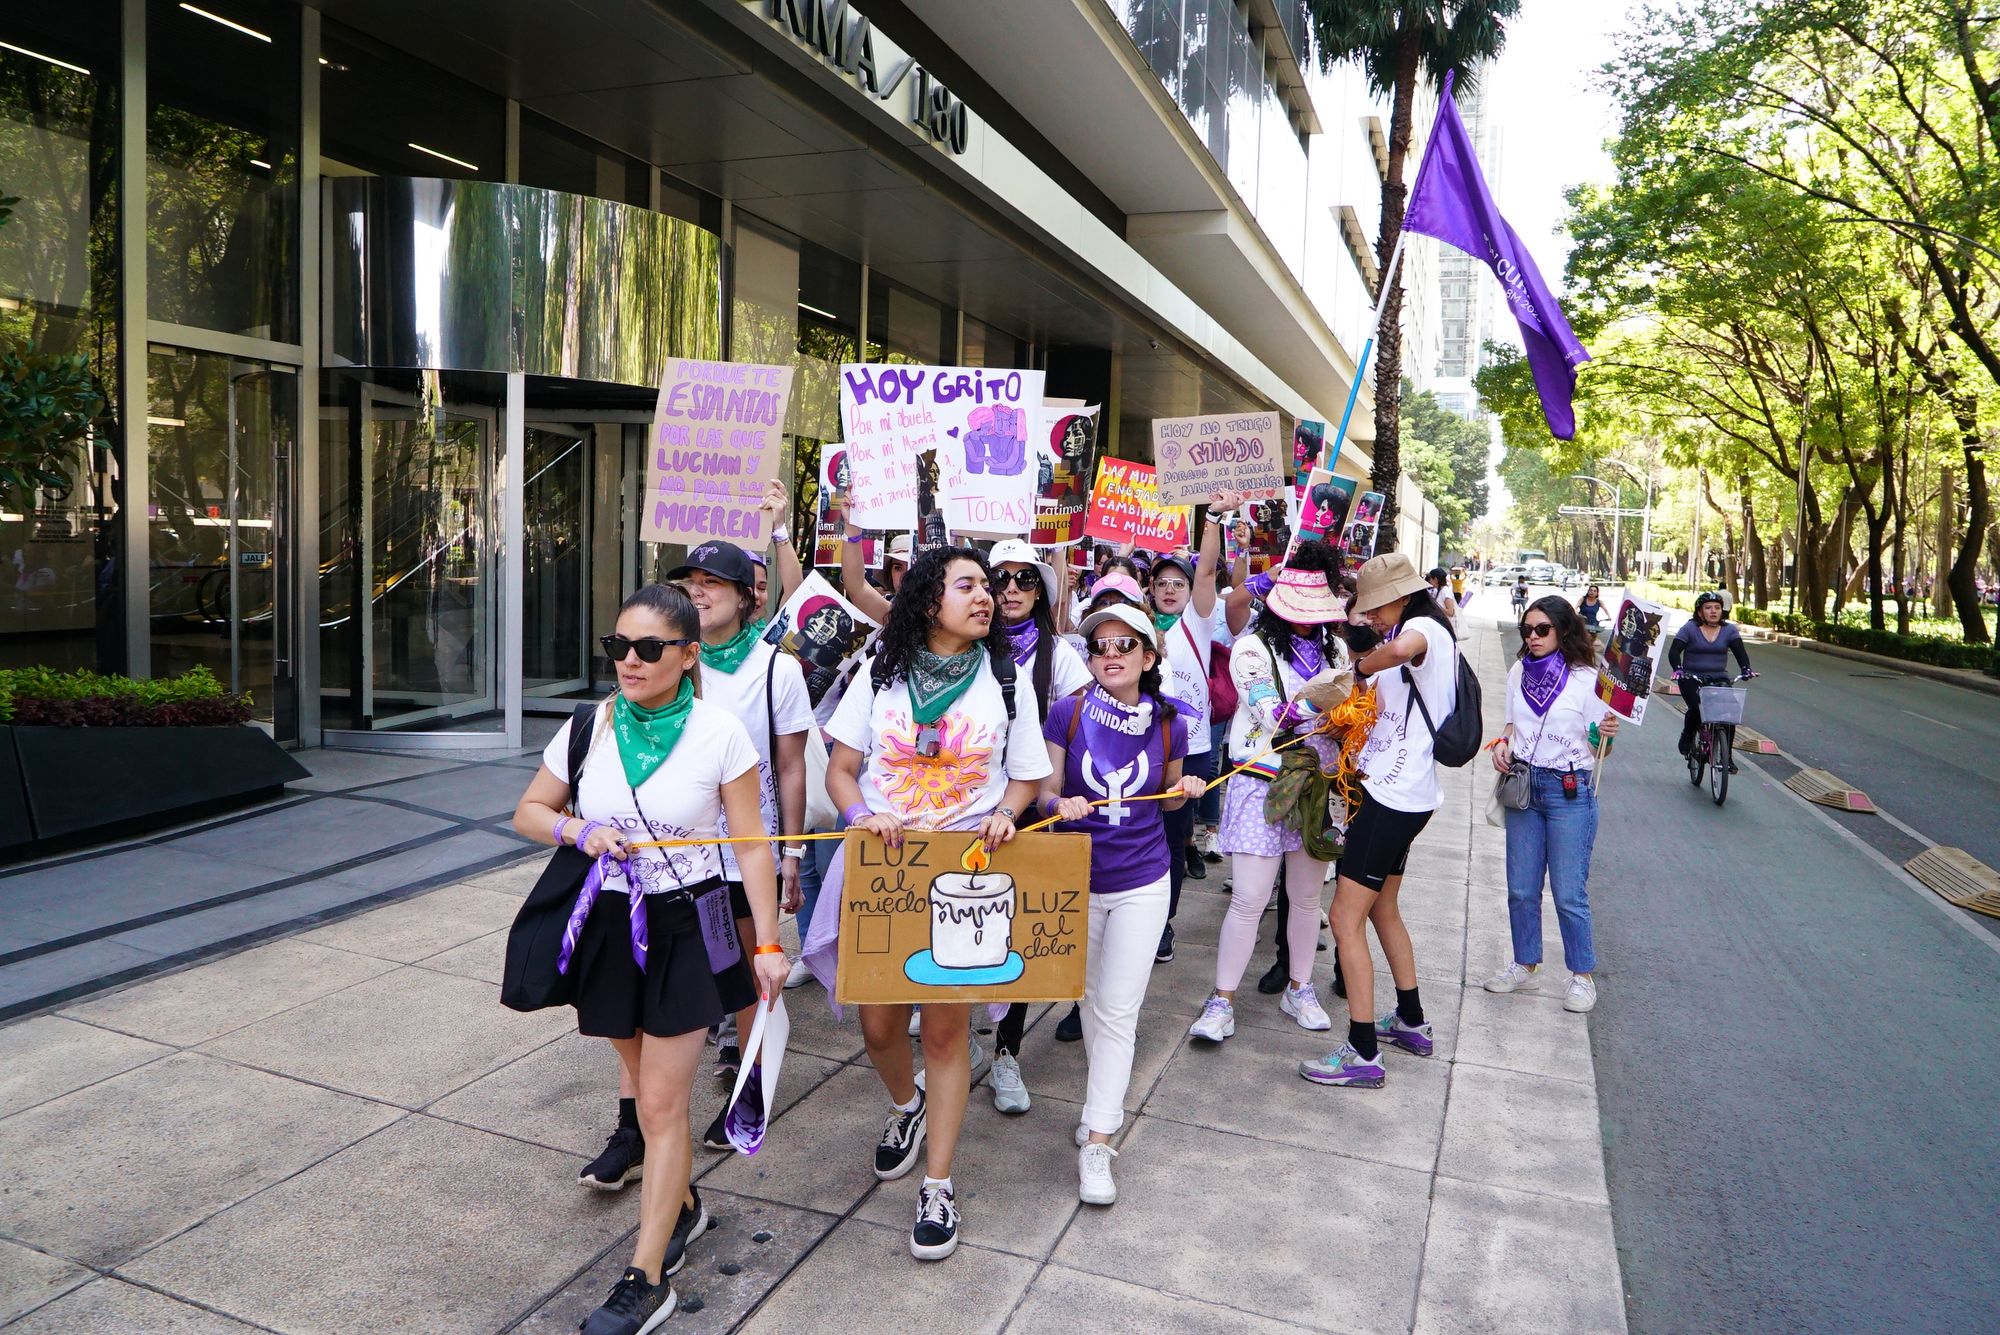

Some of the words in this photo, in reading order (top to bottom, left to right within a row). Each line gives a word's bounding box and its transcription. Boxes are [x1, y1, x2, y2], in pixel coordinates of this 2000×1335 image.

[752, 368, 781, 387] TE
[844, 367, 925, 405] HOY
[665, 382, 781, 427] ESPANTAS
[659, 423, 690, 447] POR
[696, 426, 724, 449] LAS
[730, 429, 766, 450] QUE
[1160, 422, 1194, 439] HOY
[1200, 421, 1220, 436] NO
[1226, 416, 1272, 434] TENGO
[656, 447, 741, 476] LUCHAN
[1102, 463, 1126, 478] LAS
[1129, 470, 1157, 484] MUJ
[658, 475, 686, 497] NO
[693, 478, 733, 504] POR
[1107, 482, 1159, 502] ENOJAD
[654, 501, 761, 540] MUEREN
[1036, 503, 1083, 516] Latimos
[1036, 519, 1072, 530] juntas
[1101, 515, 1118, 528] EL
[1123, 520, 1174, 540] MUNDO
[1082, 699, 1090, 714] Y
[1089, 705, 1140, 736] UNIDAS
[649, 818, 696, 839] está
[859, 839, 930, 868] LUZ
[870, 868, 916, 894] al
[849, 890, 927, 914] miedo
[1022, 890, 1080, 914] LUZ
[721, 905, 735, 951] adidas
[1031, 914, 1074, 938] al
[1023, 936, 1077, 960] dolor
